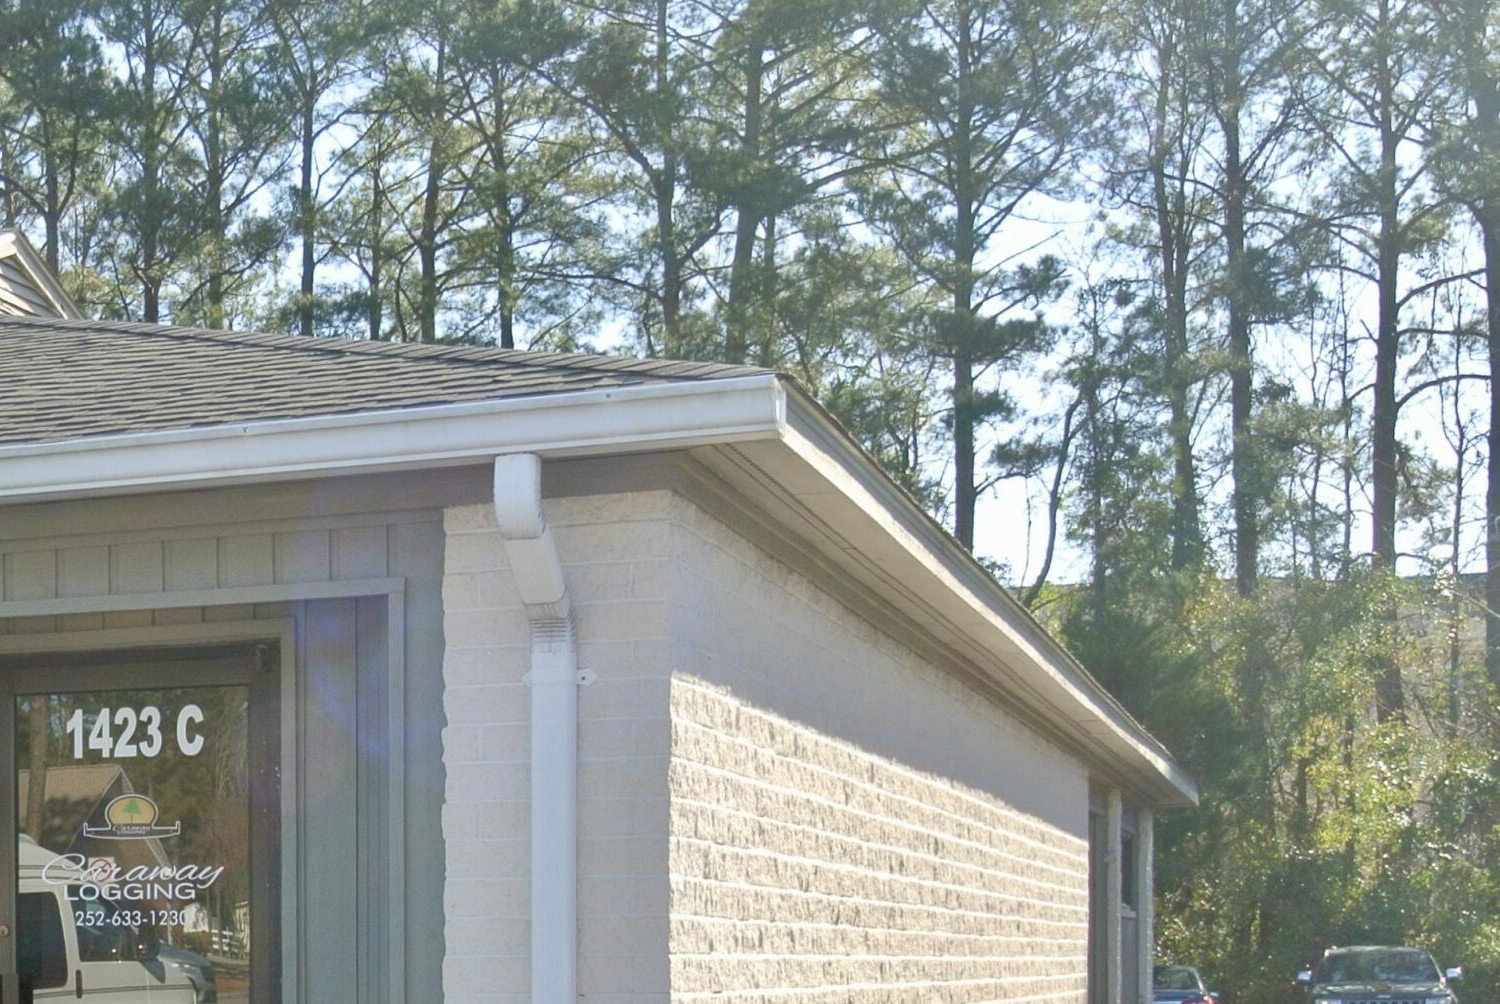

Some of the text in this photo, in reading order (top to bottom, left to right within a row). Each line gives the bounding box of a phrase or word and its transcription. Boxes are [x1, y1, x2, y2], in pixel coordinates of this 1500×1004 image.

[66, 704, 205, 759] 1423 C
[41, 853, 225, 888] Caraway
[63, 883, 196, 901] LOGGING
[75, 911, 188, 926] 252-633-1230
